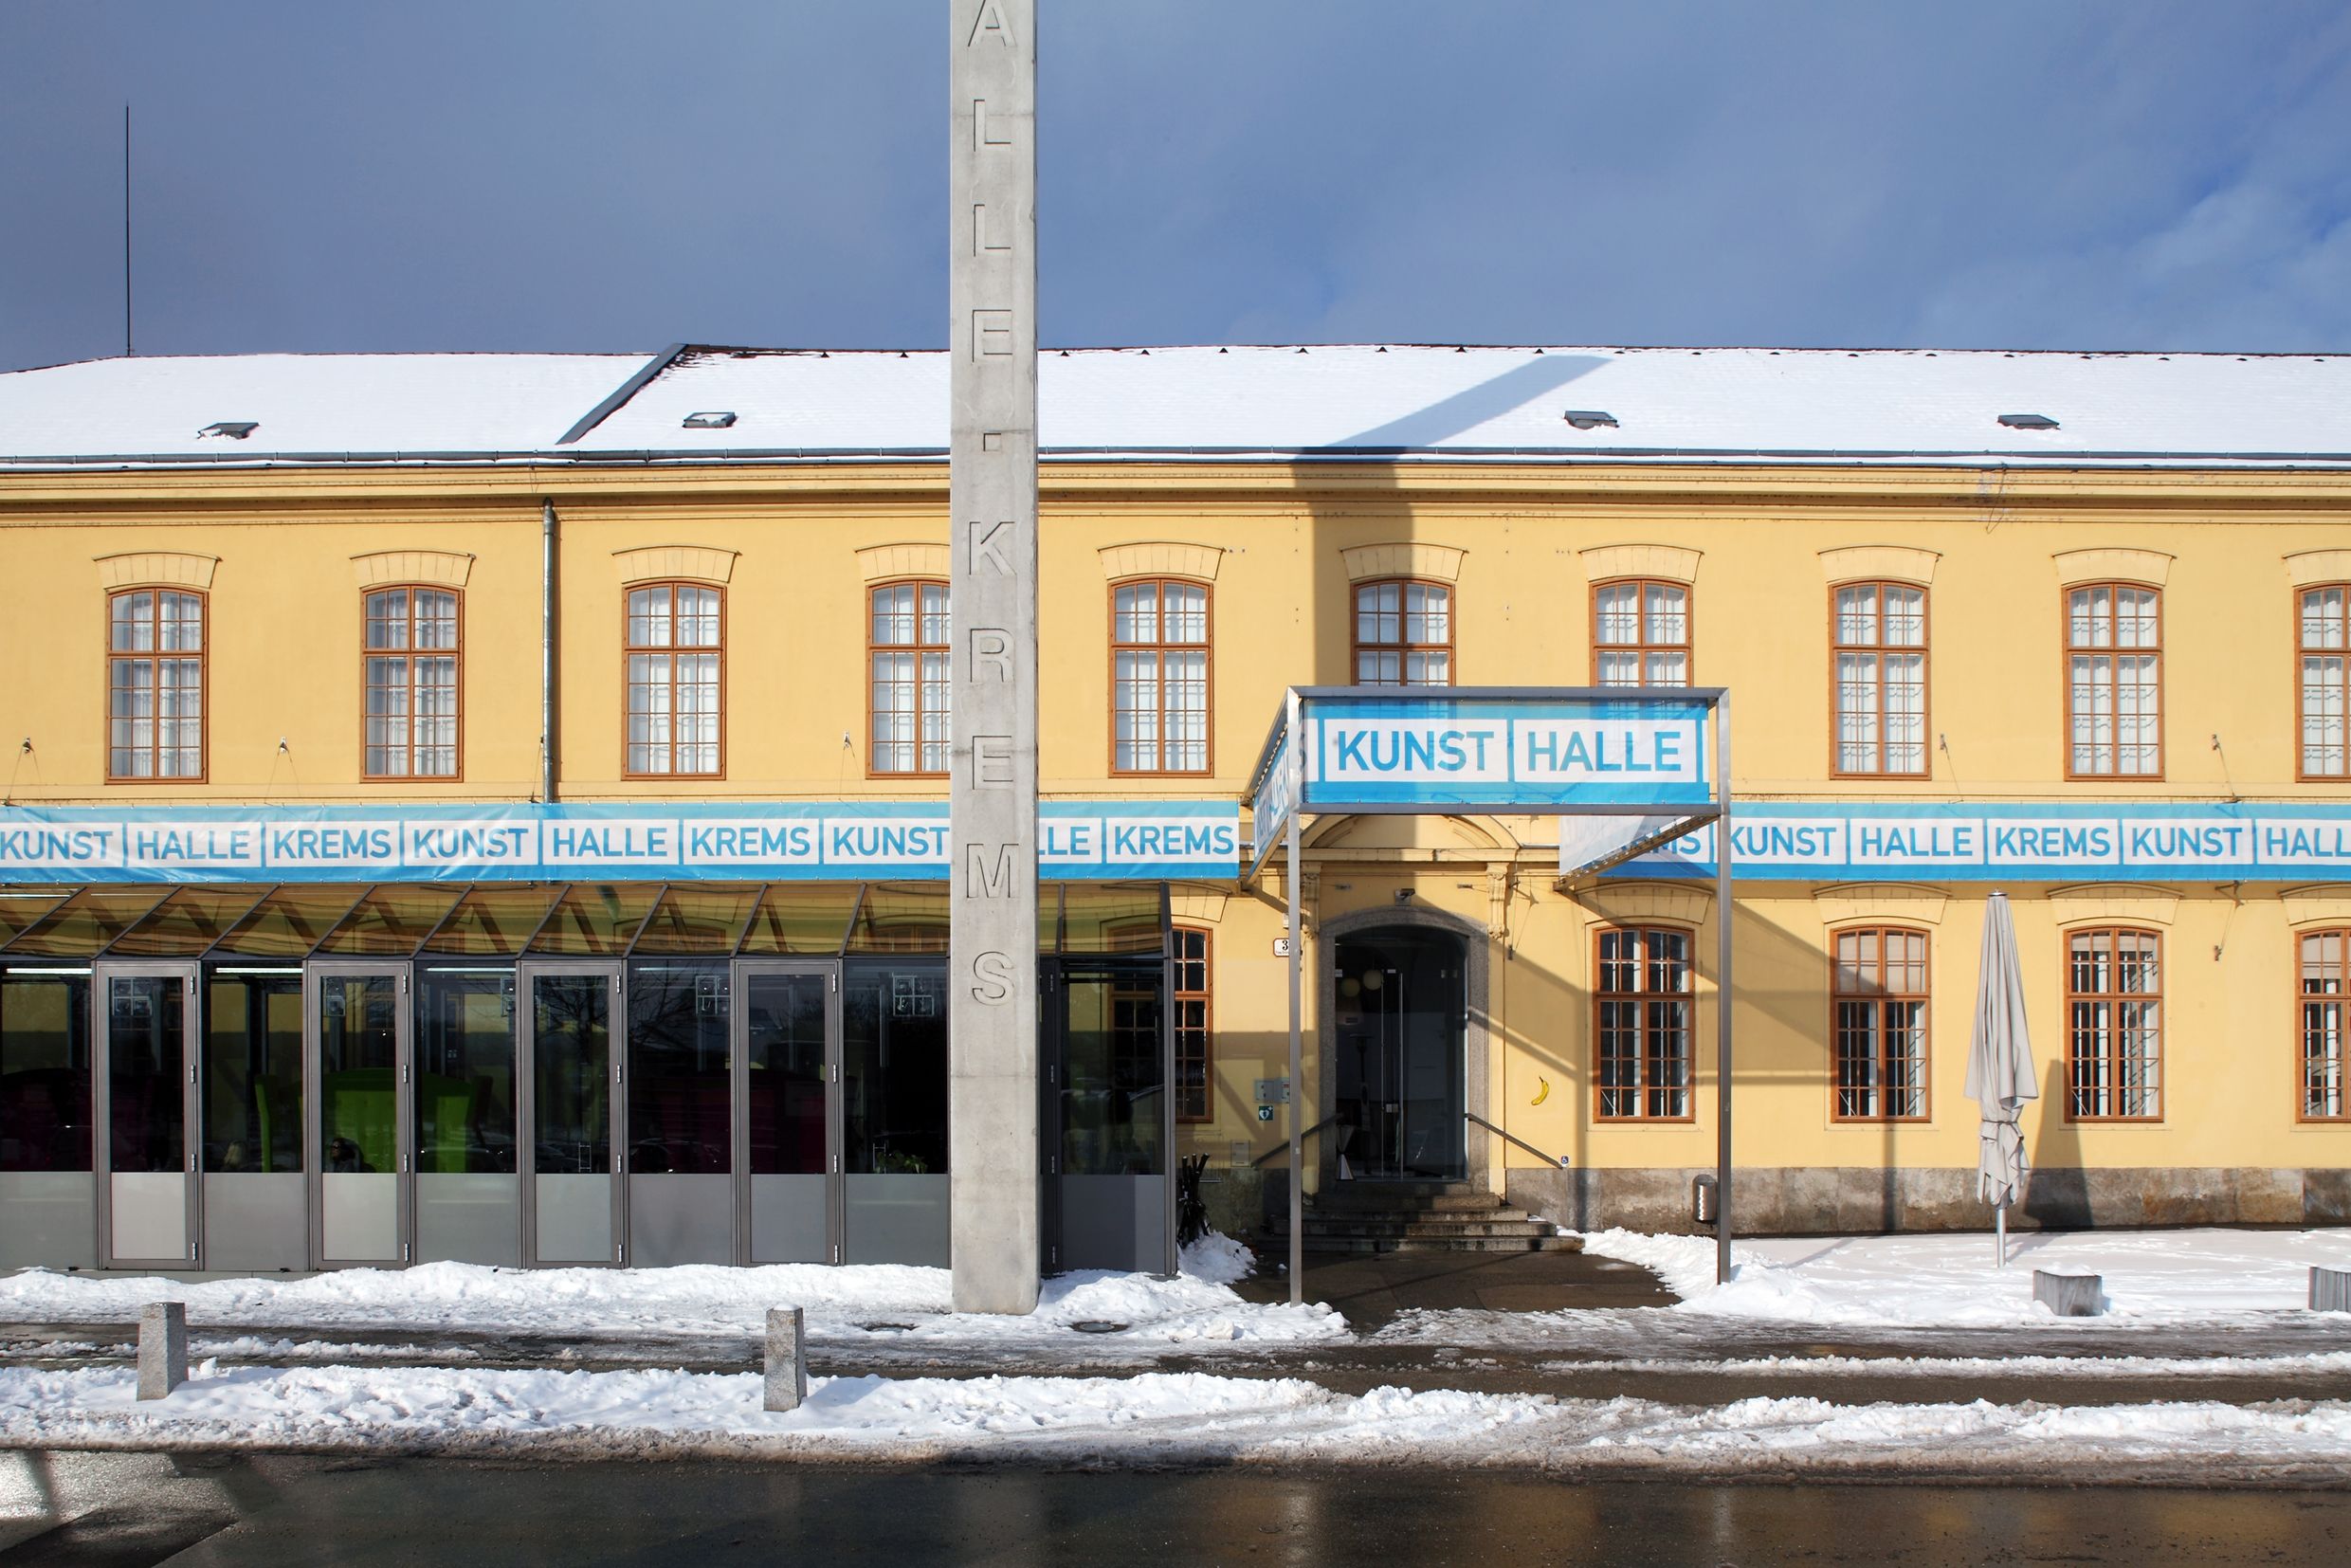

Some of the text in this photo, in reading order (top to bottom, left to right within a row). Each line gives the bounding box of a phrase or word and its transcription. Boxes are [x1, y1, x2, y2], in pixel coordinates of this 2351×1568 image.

[1338, 730, 1682, 772] KUNST HALLE
[0, 830, 113, 860] KUNST
[137, 830, 249, 860] HALLE
[273, 829, 392, 859] KREMS
[413, 828, 529, 858] KUNST
[553, 828, 667, 857] HALLE
[691, 827, 811, 857] KREMS
[833, 827, 950, 856] KUNST
[1115, 826, 1234, 855] KREMS
[1731, 826, 1837, 856] KUNST
[1861, 827, 1973, 856] HALLE
[1996, 827, 2111, 857] KREMS
[2132, 827, 2245, 857] KUNST
